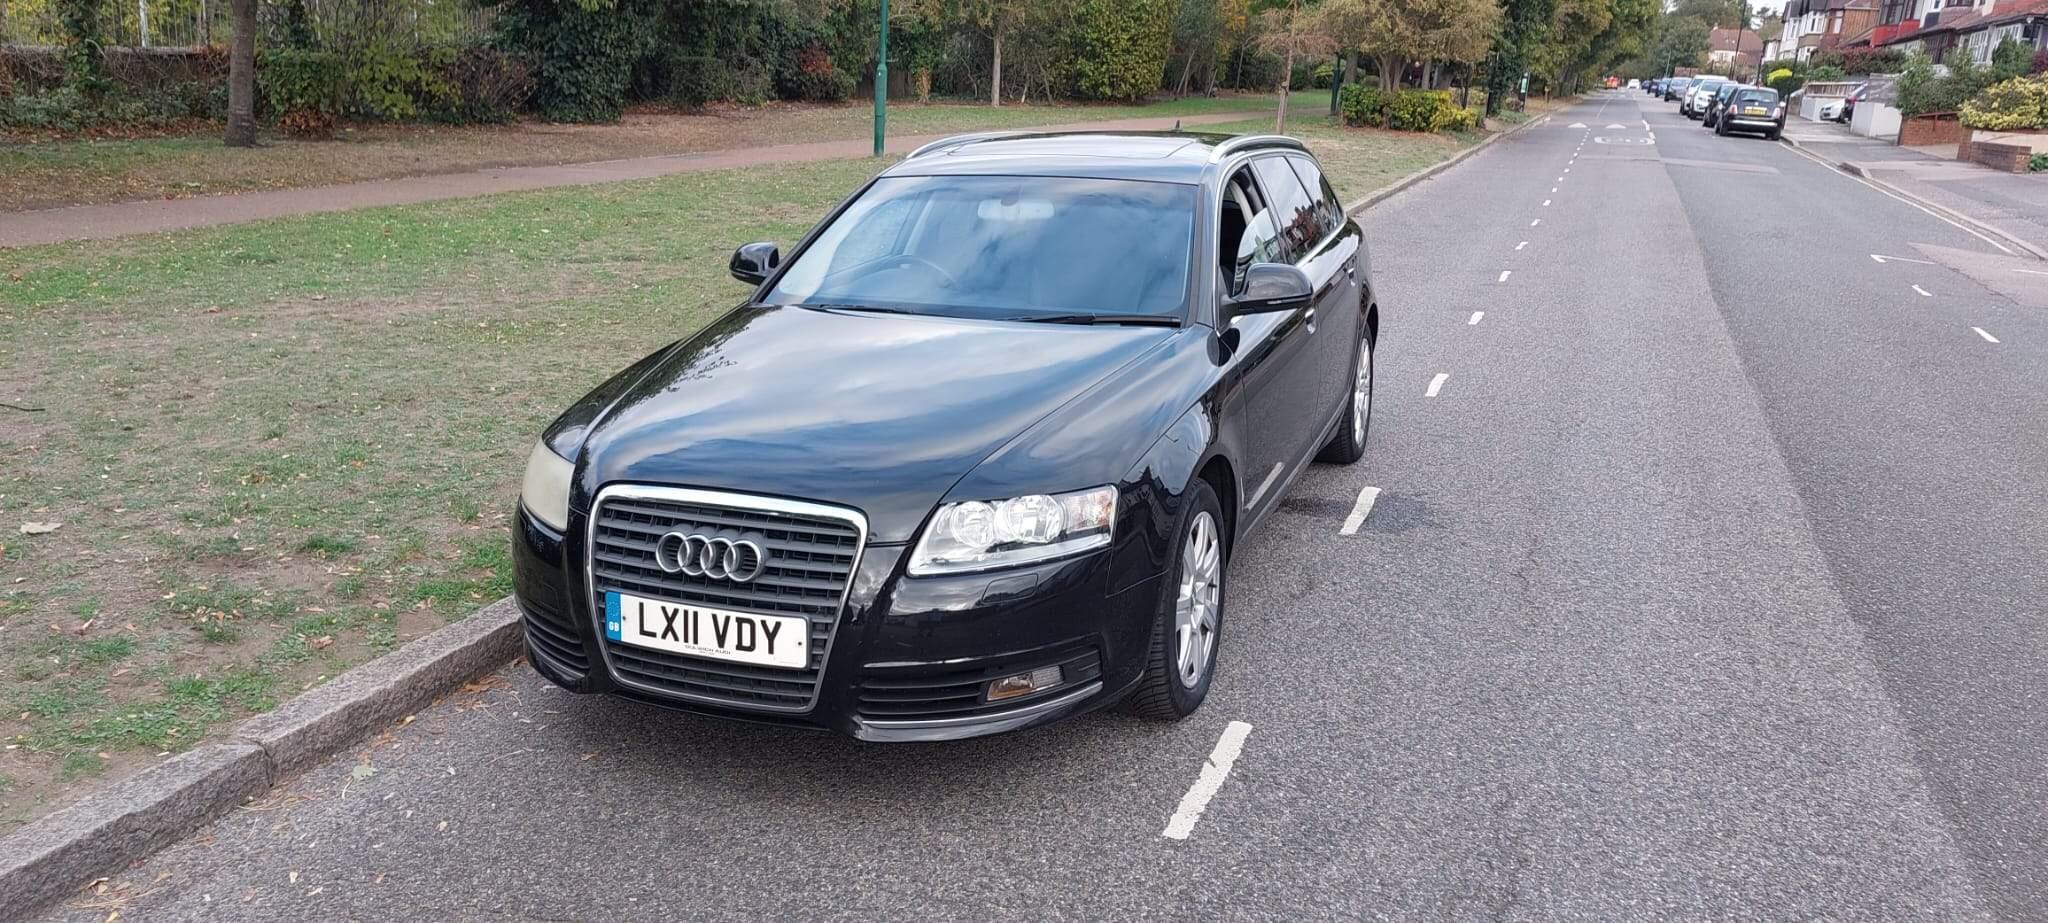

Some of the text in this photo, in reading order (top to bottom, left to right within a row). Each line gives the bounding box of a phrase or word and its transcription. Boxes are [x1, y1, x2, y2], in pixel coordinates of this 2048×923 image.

[608, 621, 620, 632] GB
[639, 601, 782, 655] LX11 VDY
